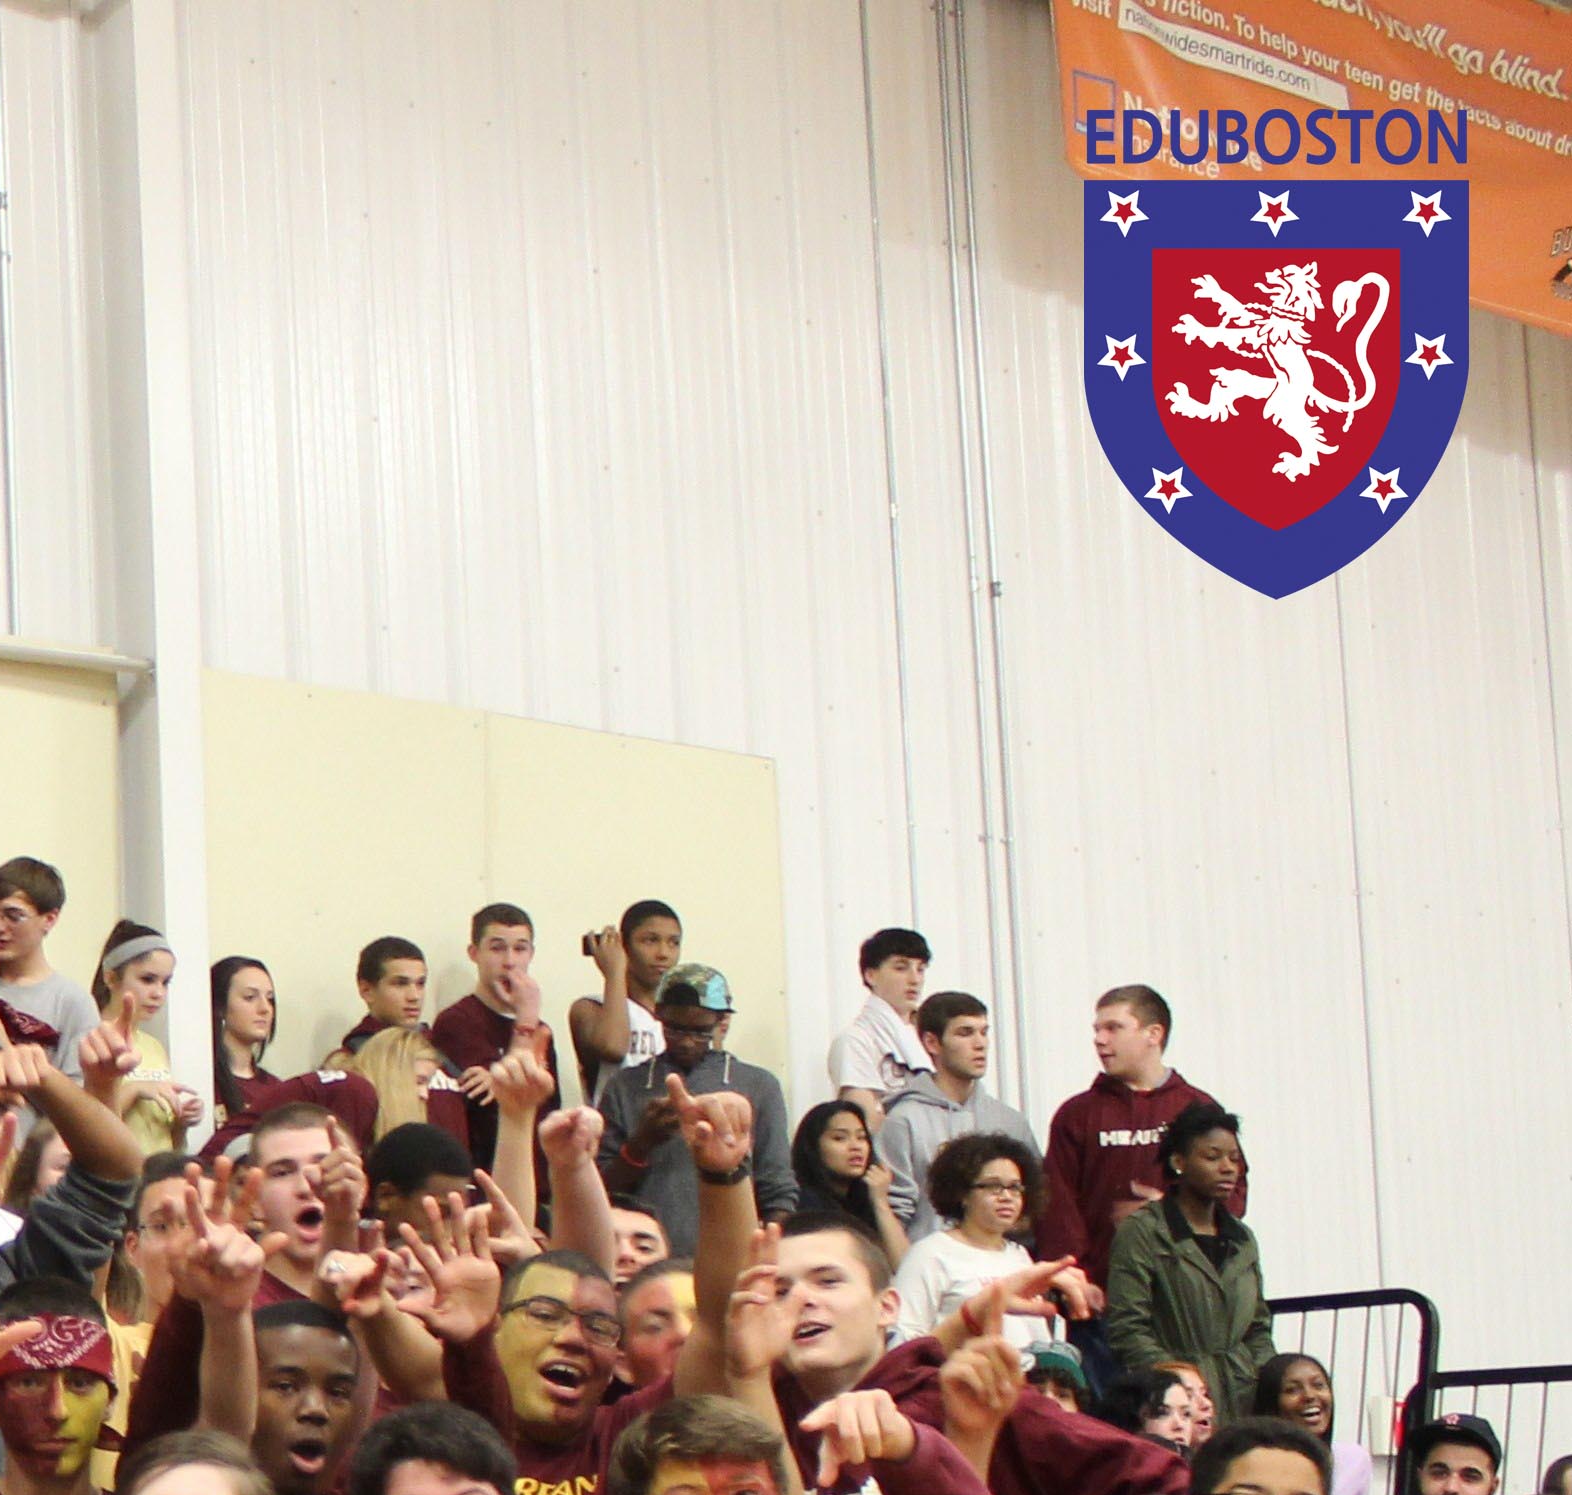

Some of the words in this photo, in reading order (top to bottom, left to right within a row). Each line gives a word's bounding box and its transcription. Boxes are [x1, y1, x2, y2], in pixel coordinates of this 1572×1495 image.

[1232, 13, 1256, 41] To
[1259, 24, 1298, 60] help
[1302, 44, 1340, 74] your
[1343, 59, 1383, 92] teen
[1388, 80, 1421, 104] get
[1425, 85, 1454, 114] the
[1448, 43, 1484, 76] go
[1489, 48, 1570, 101] blind.
